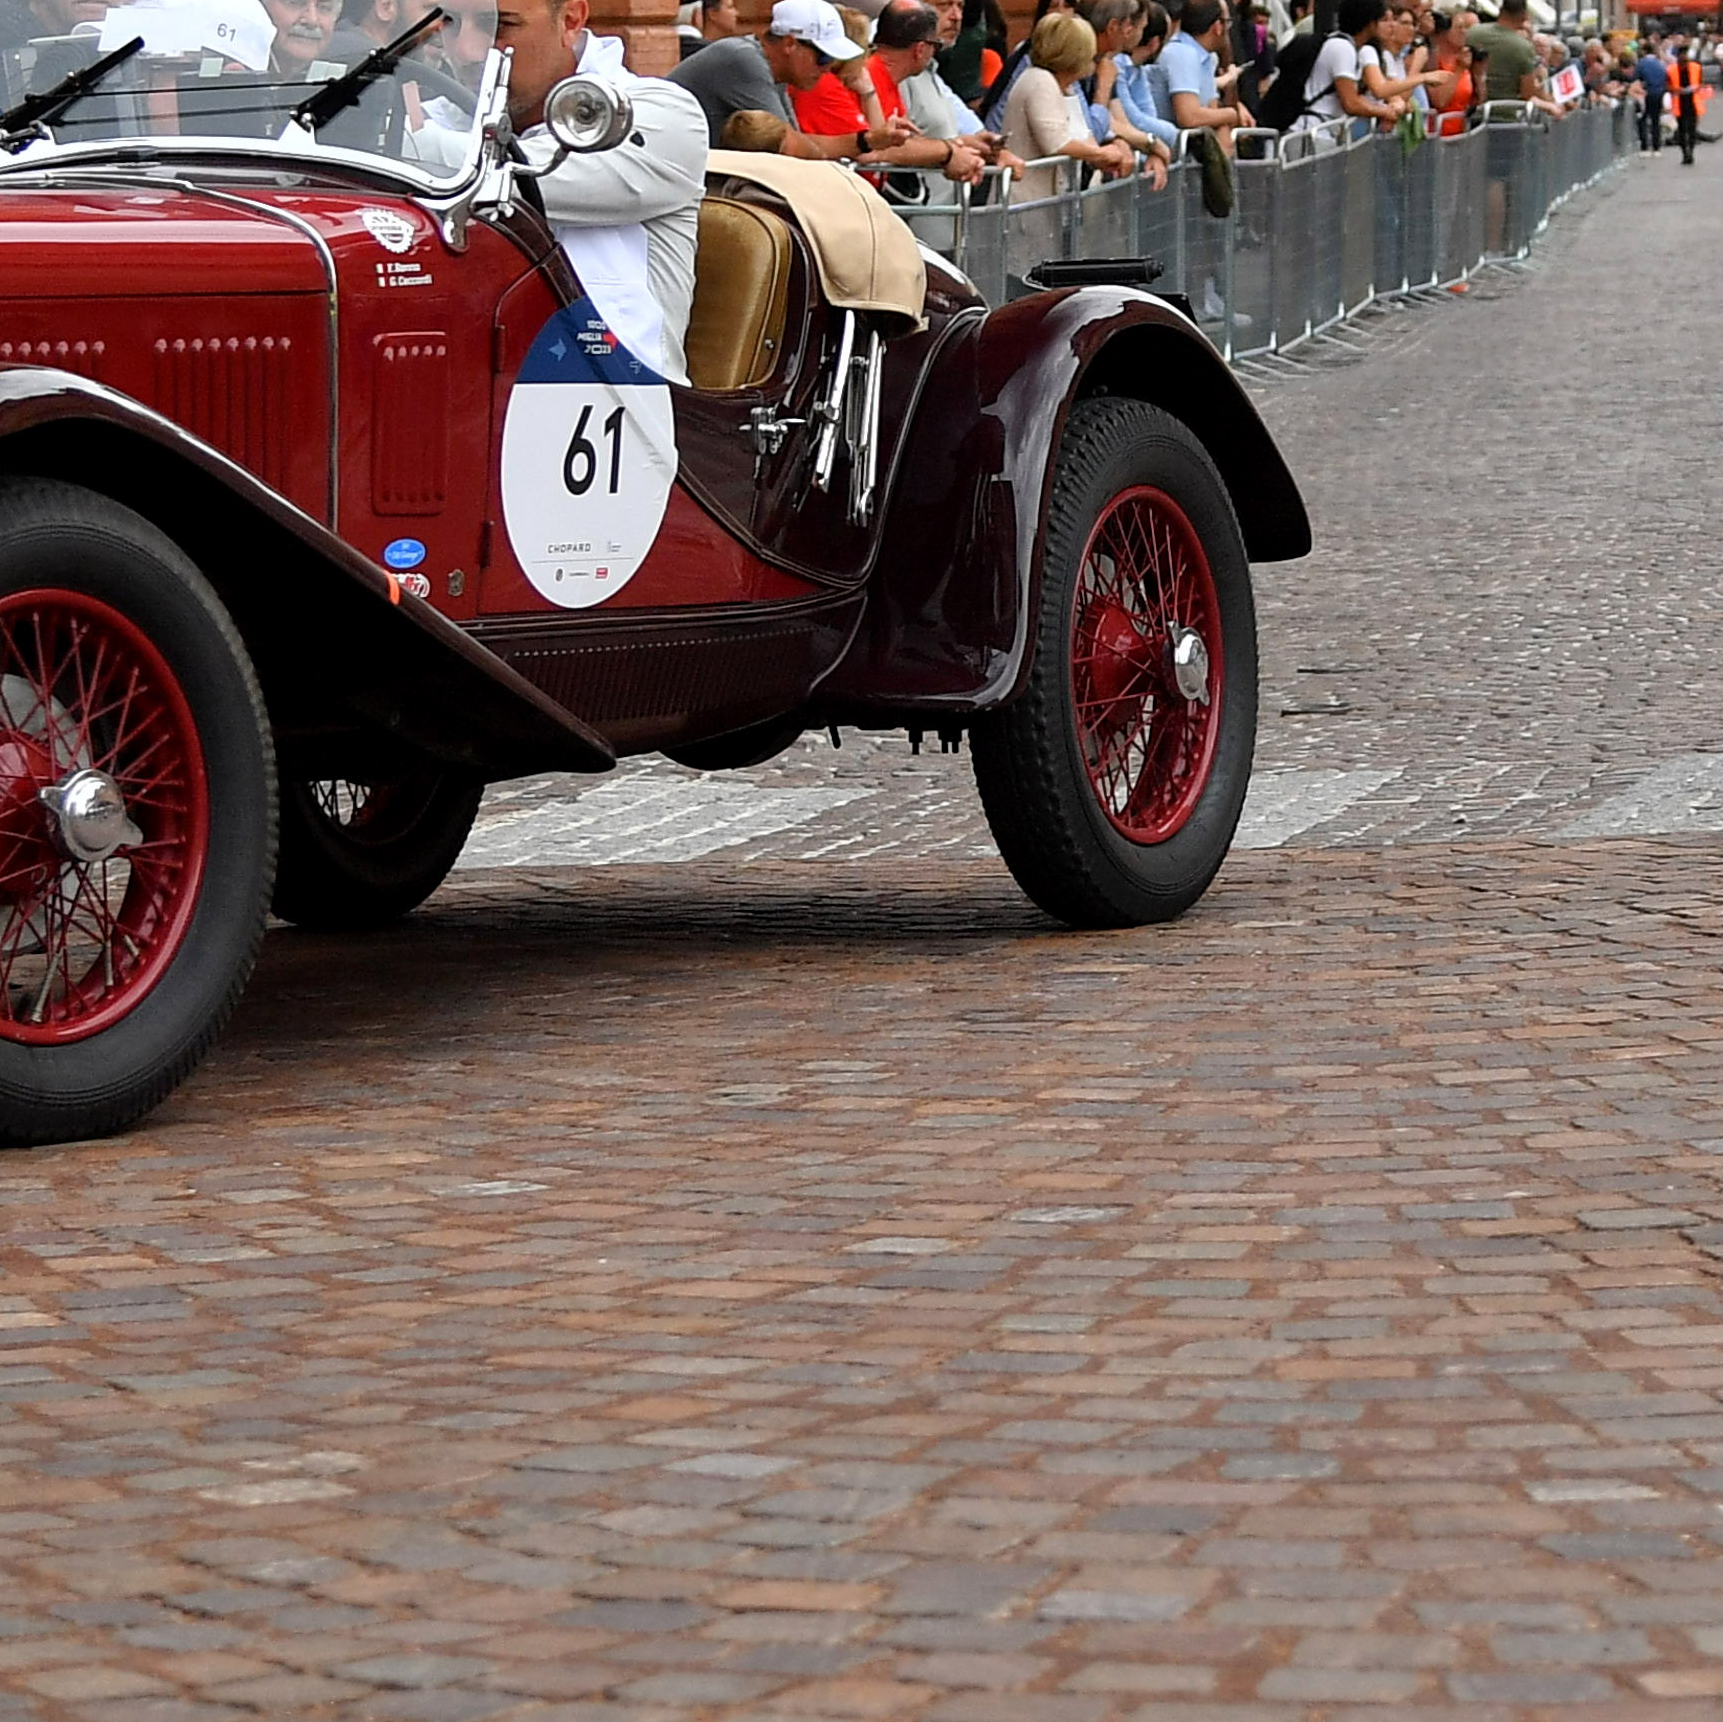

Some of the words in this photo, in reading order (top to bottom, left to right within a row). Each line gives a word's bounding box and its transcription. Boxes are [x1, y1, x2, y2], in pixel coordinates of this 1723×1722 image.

[216, 22, 237, 42] 61
[563, 404, 626, 496] 61
[547, 543, 591, 554] CHOPARD
